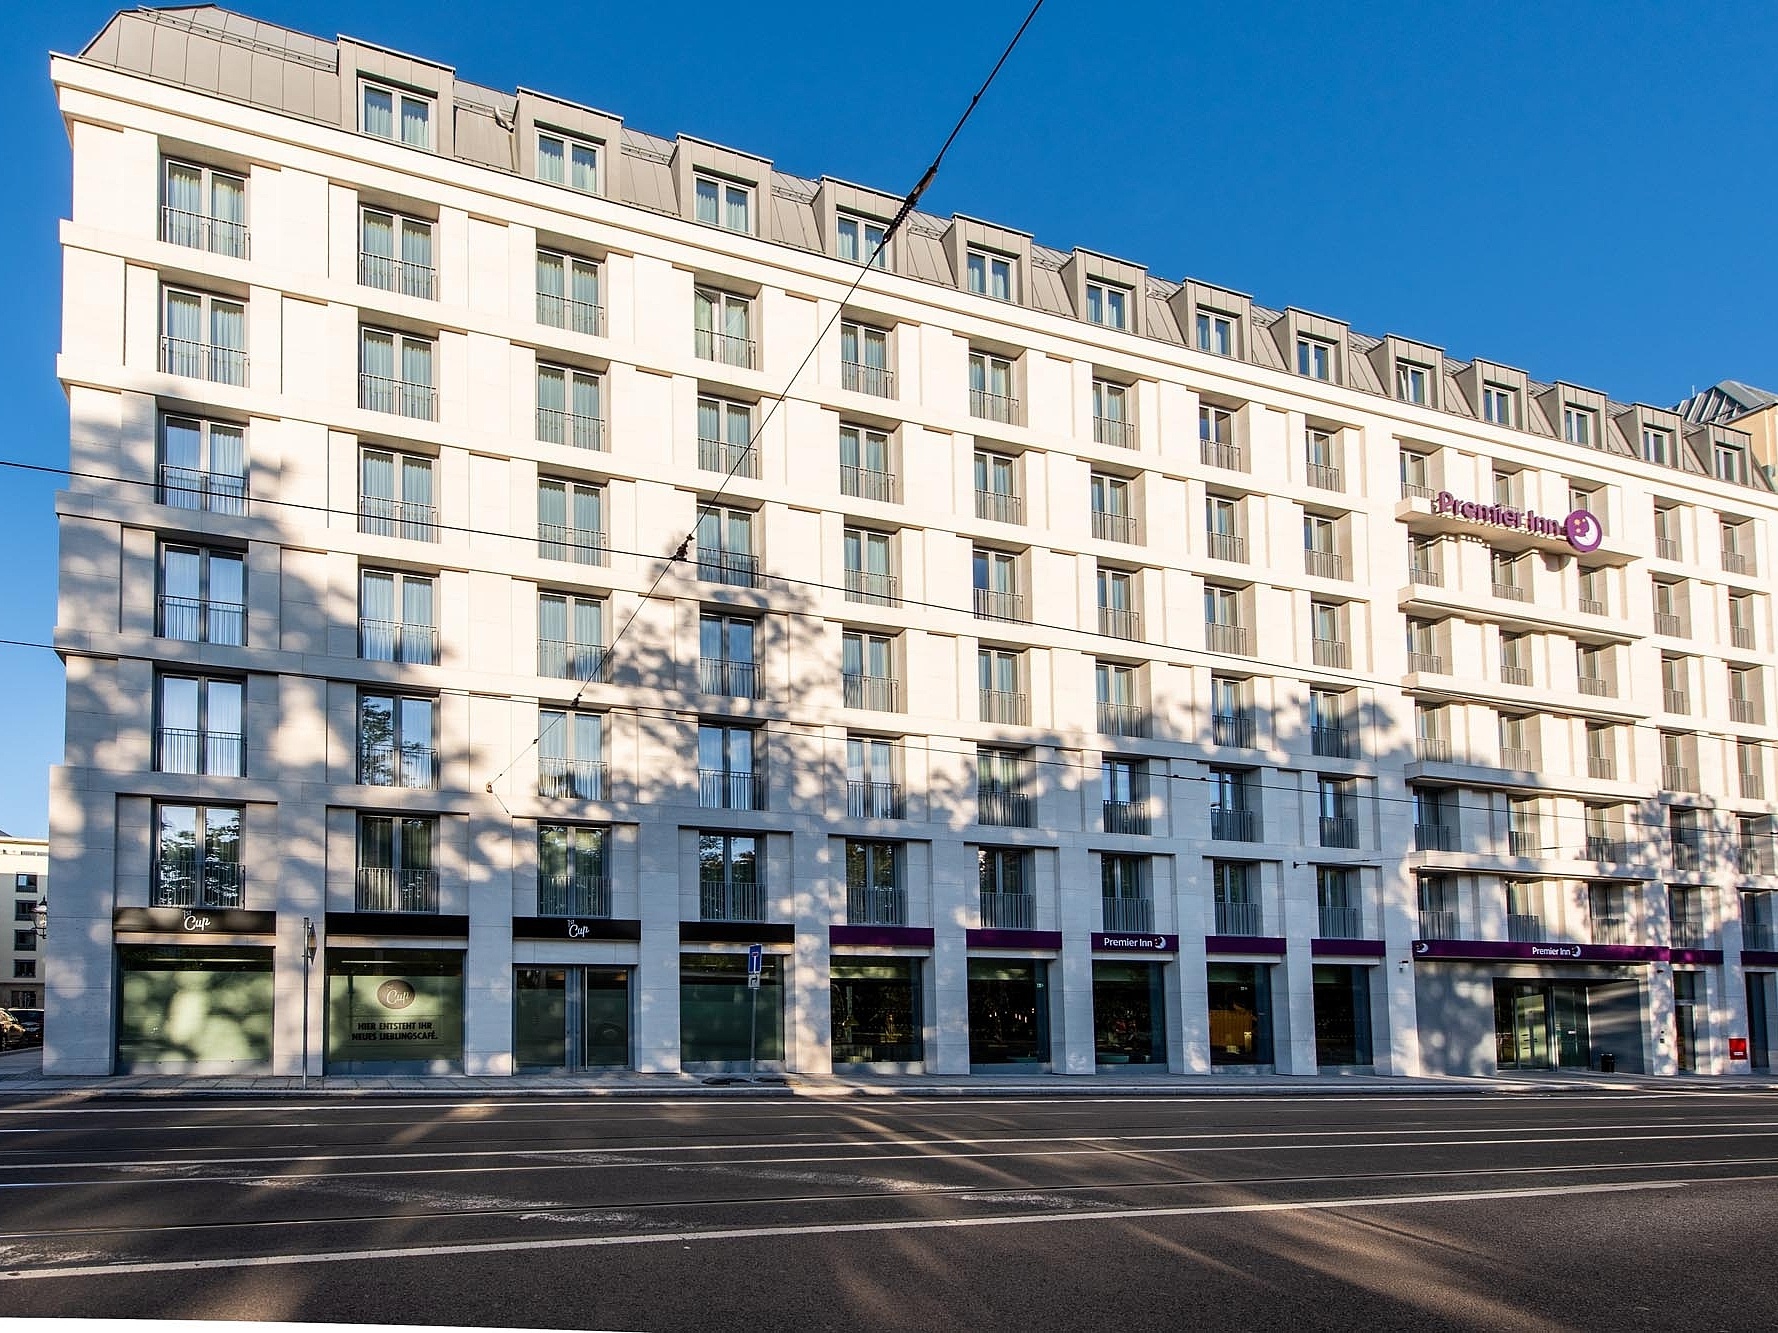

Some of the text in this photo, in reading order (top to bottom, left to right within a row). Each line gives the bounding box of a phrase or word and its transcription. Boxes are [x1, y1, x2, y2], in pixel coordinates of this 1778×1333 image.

[1438, 491, 1560, 536] Premier Inn
[184, 915, 211, 931] Cup
[569, 924, 590, 938] Cup
[1104, 937, 1153, 947] Premier Inn
[1532, 946, 1571, 956] Premier Inn
[386, 989, 411, 1005] Cup
[358, 1022, 432, 1030] HIER ENTSTEHT IHR
[352, 1032, 376, 1040] NEUES
